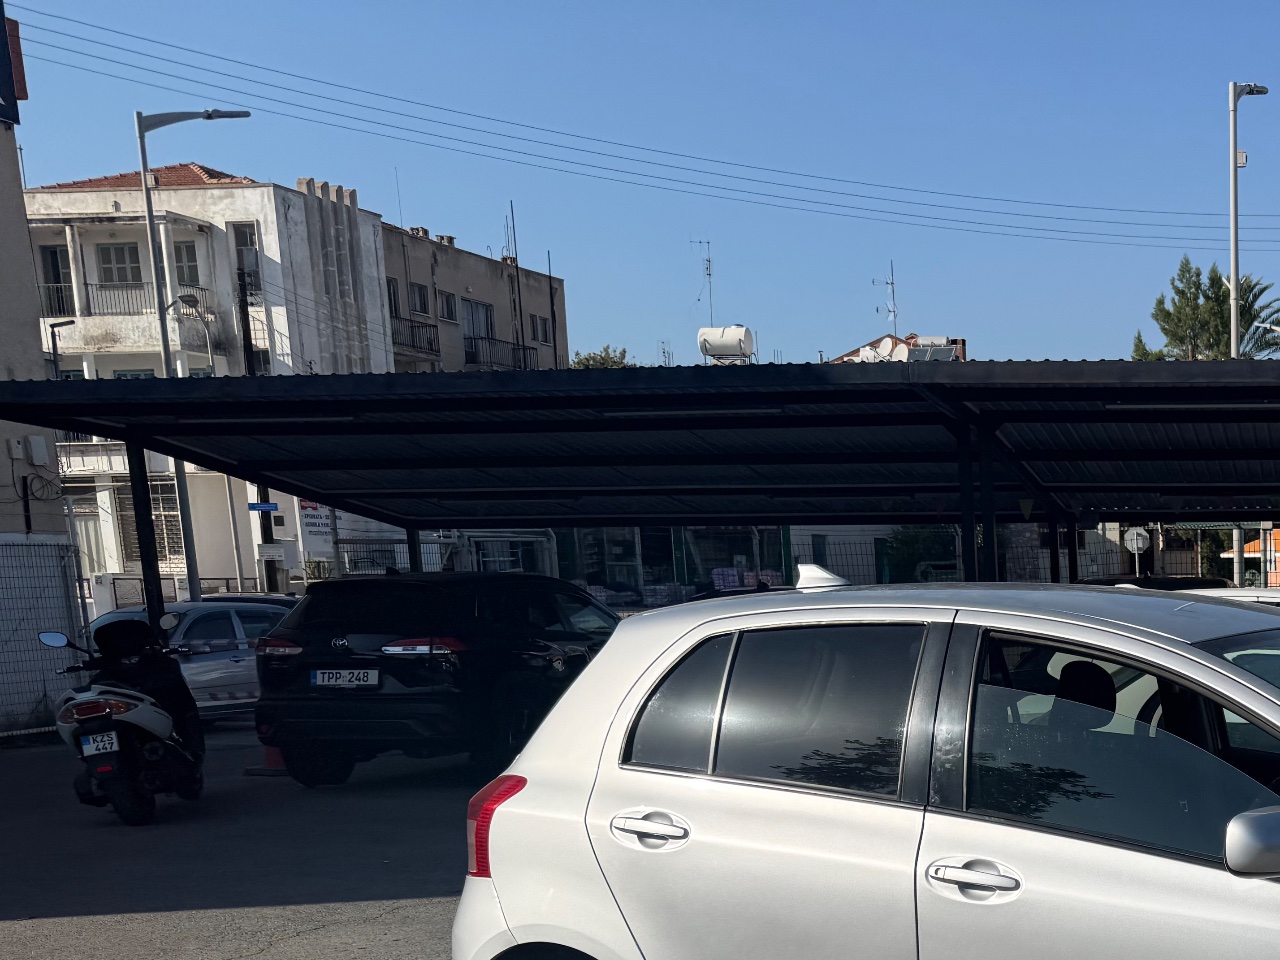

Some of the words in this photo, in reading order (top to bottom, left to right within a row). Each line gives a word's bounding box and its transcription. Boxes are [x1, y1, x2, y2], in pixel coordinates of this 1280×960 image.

[320, 671, 341, 683] TPP
[348, 671, 369, 683] 248
[92, 733, 114, 744] KZS
[95, 742, 114, 752] 447
